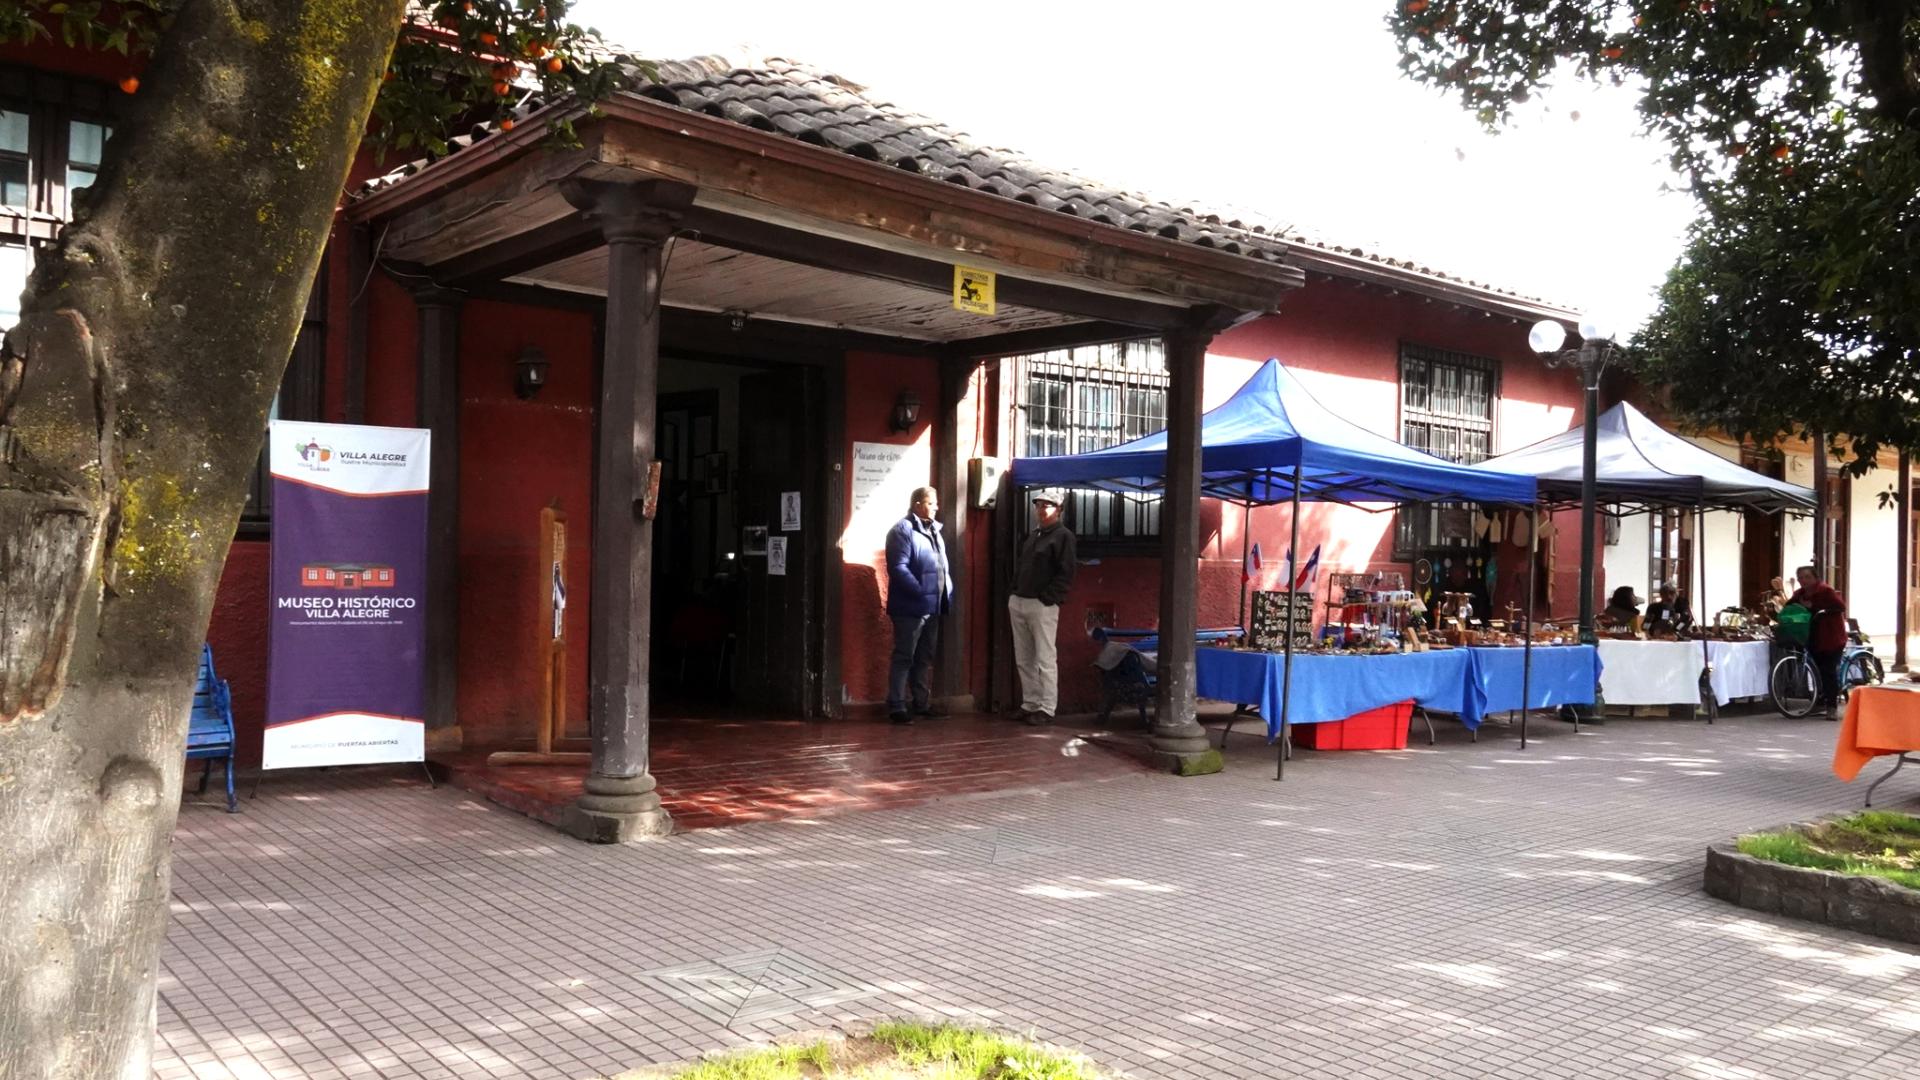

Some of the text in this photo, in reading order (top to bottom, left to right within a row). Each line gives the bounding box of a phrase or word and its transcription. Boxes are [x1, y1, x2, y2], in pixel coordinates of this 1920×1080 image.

[339, 451, 407, 462] VILLA ALEGRE
[278, 595, 416, 609] MUSEO HISTÓRICO
[305, 608, 390, 618] VILLA ALEGRE
